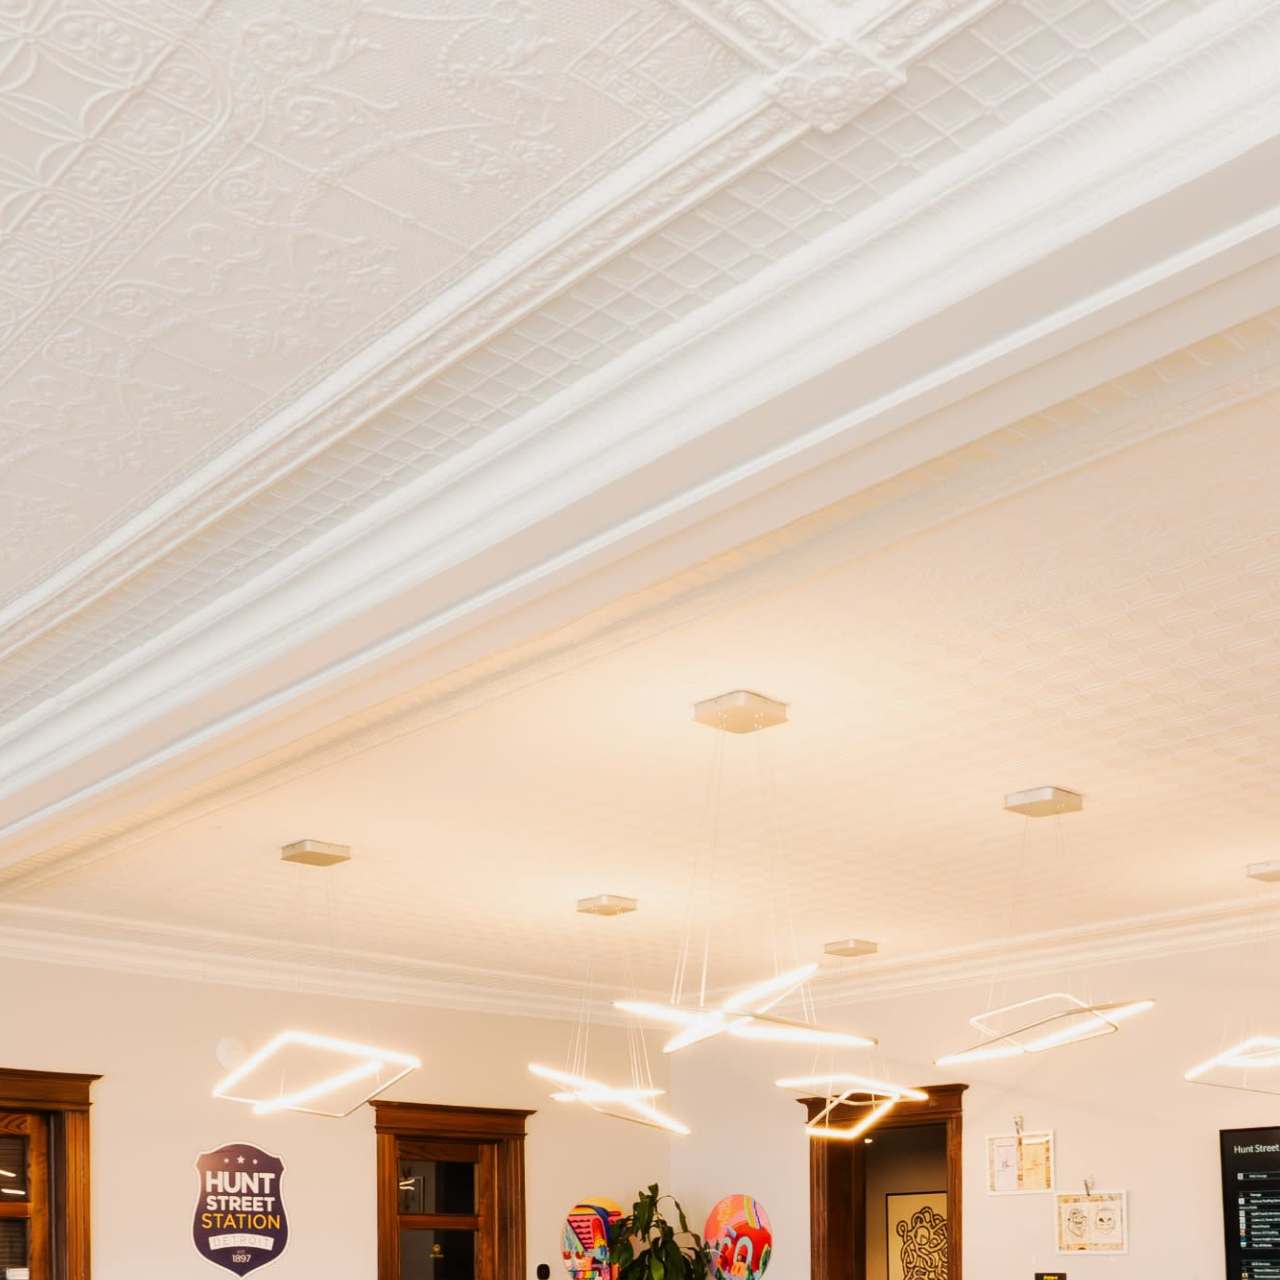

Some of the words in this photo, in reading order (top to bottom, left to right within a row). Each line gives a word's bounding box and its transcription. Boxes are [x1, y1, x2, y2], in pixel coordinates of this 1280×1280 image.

[1233, 1145, 1254, 1154] Hunt
[1255, 1144, 1280, 1153] Street
[206, 1171, 275, 1194] HUNT
[206, 1195, 276, 1212] STREET
[201, 1212, 281, 1230] STATION
[232, 1254, 252, 1263] 1897
